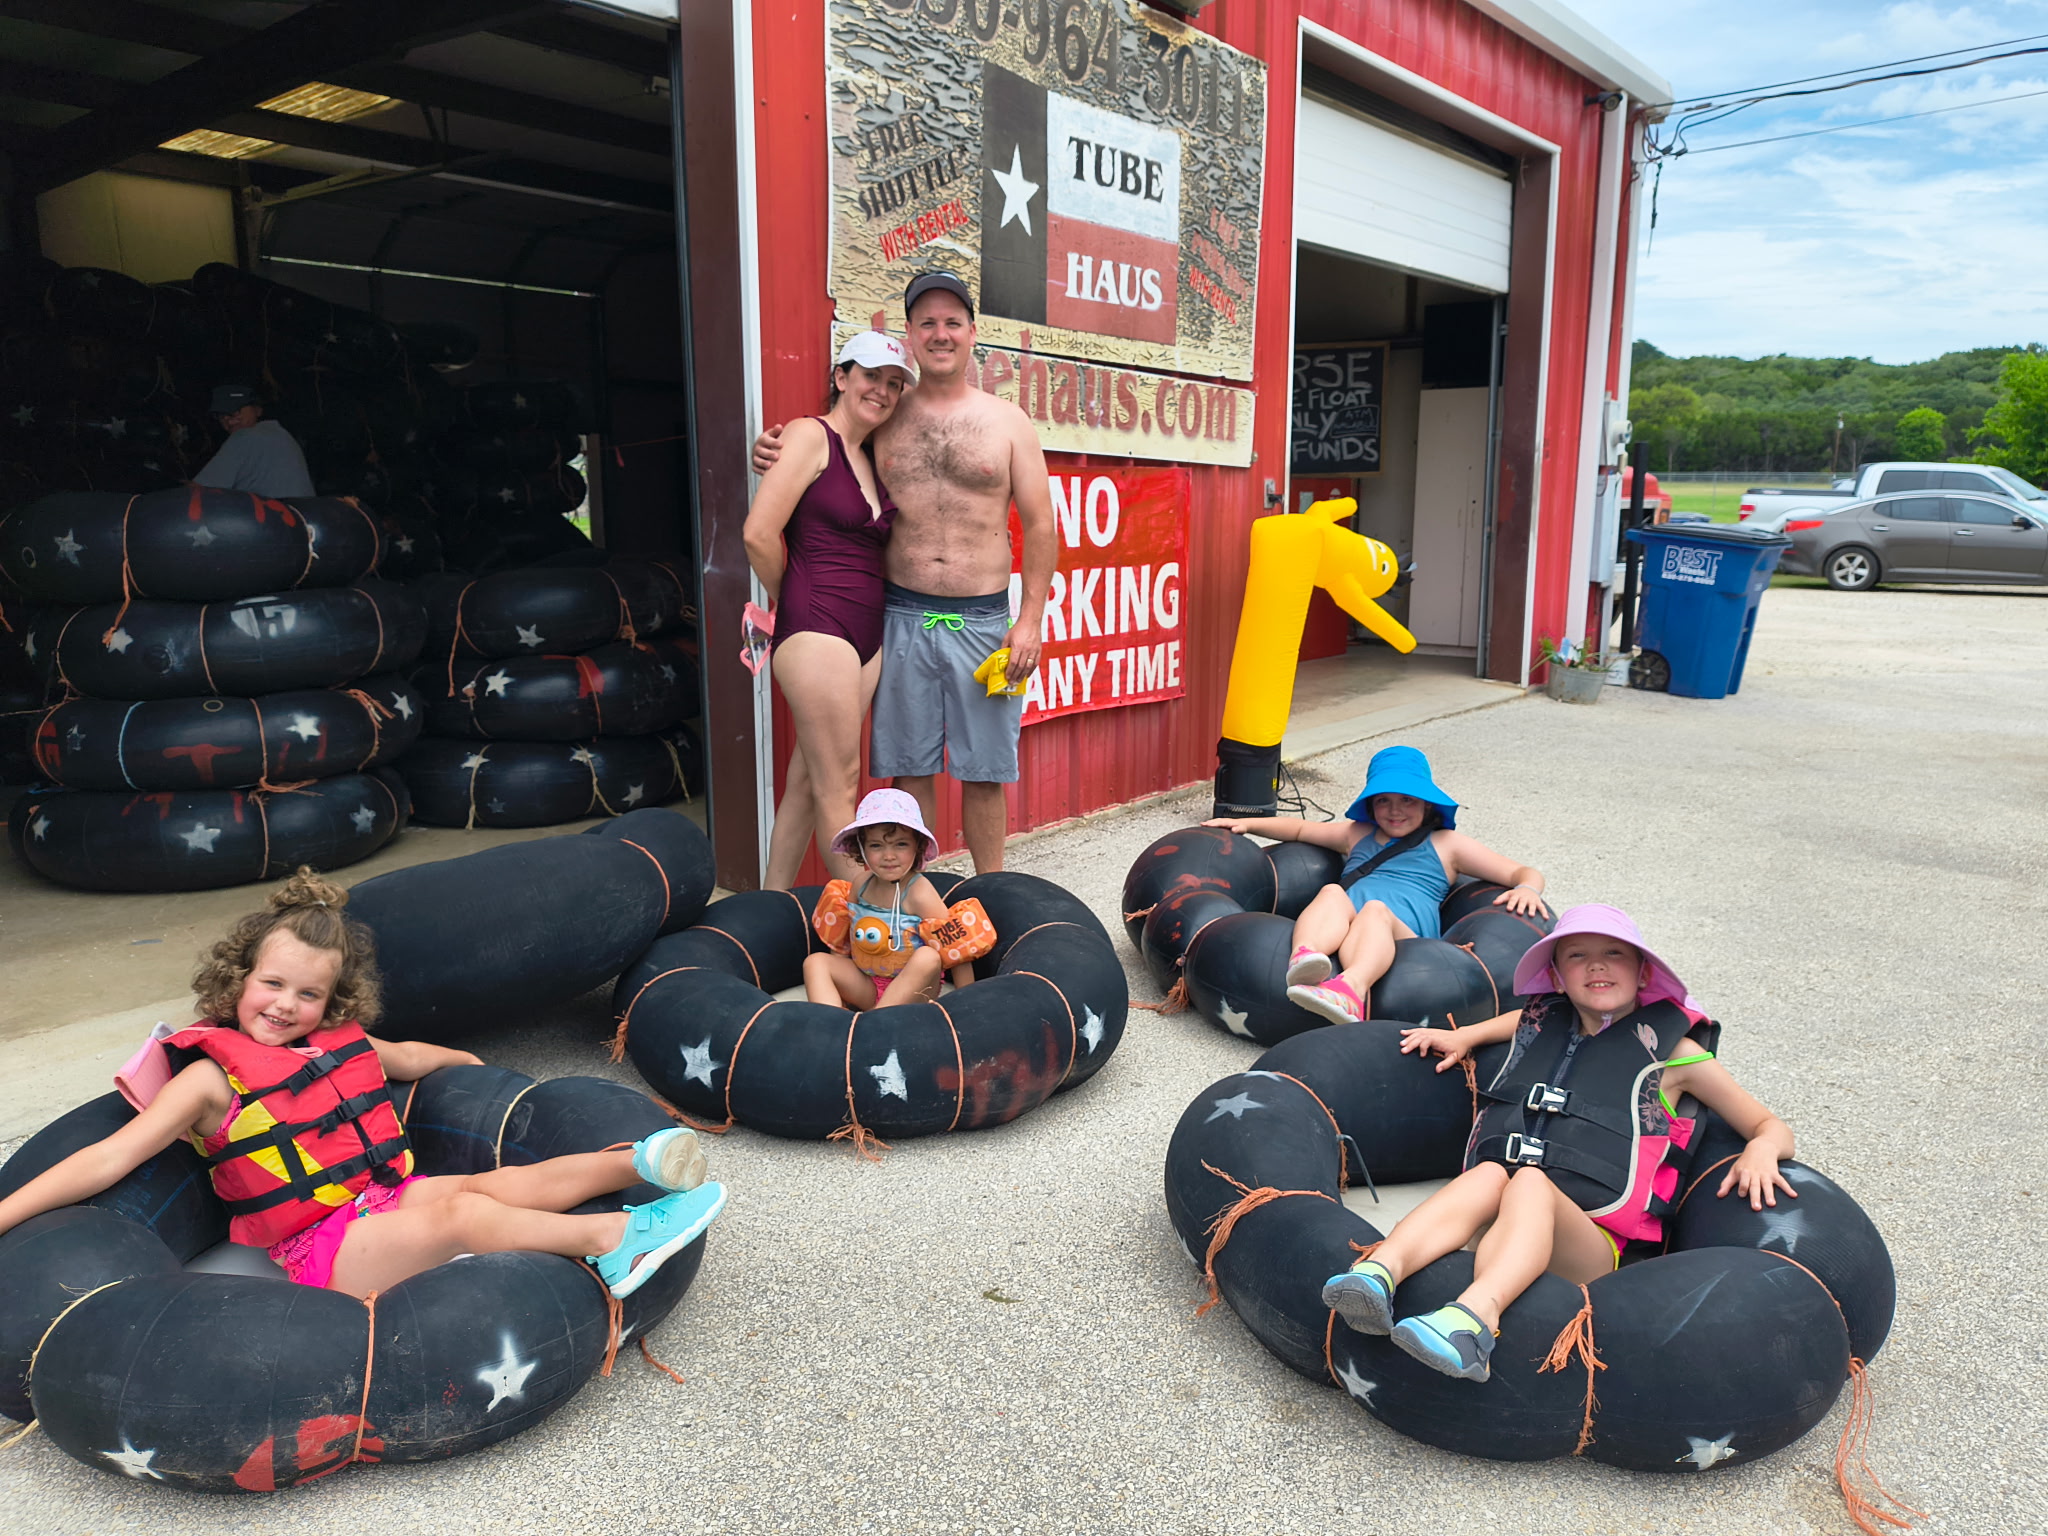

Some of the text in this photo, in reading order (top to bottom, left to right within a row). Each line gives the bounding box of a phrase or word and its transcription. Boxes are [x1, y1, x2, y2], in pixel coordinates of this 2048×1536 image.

[880, 0, 1244, 142] 0-964-3011
[1068, 136, 1164, 203] TUBE
[879, 198, 969, 263] WITH RENTAL
[1065, 252, 1162, 311] HAUS
[871, 309, 1237, 442] ehaus.com
[1308, 388, 1373, 410] FLOAT
[1048, 475, 1120, 548] NO
[1662, 545, 1723, 577] BEST
[1008, 562, 1179, 643] RKING
[1022, 640, 1180, 714] ANY TIME
[931, 918, 962, 940] TUBE
[940, 927, 967, 948] HAUS
